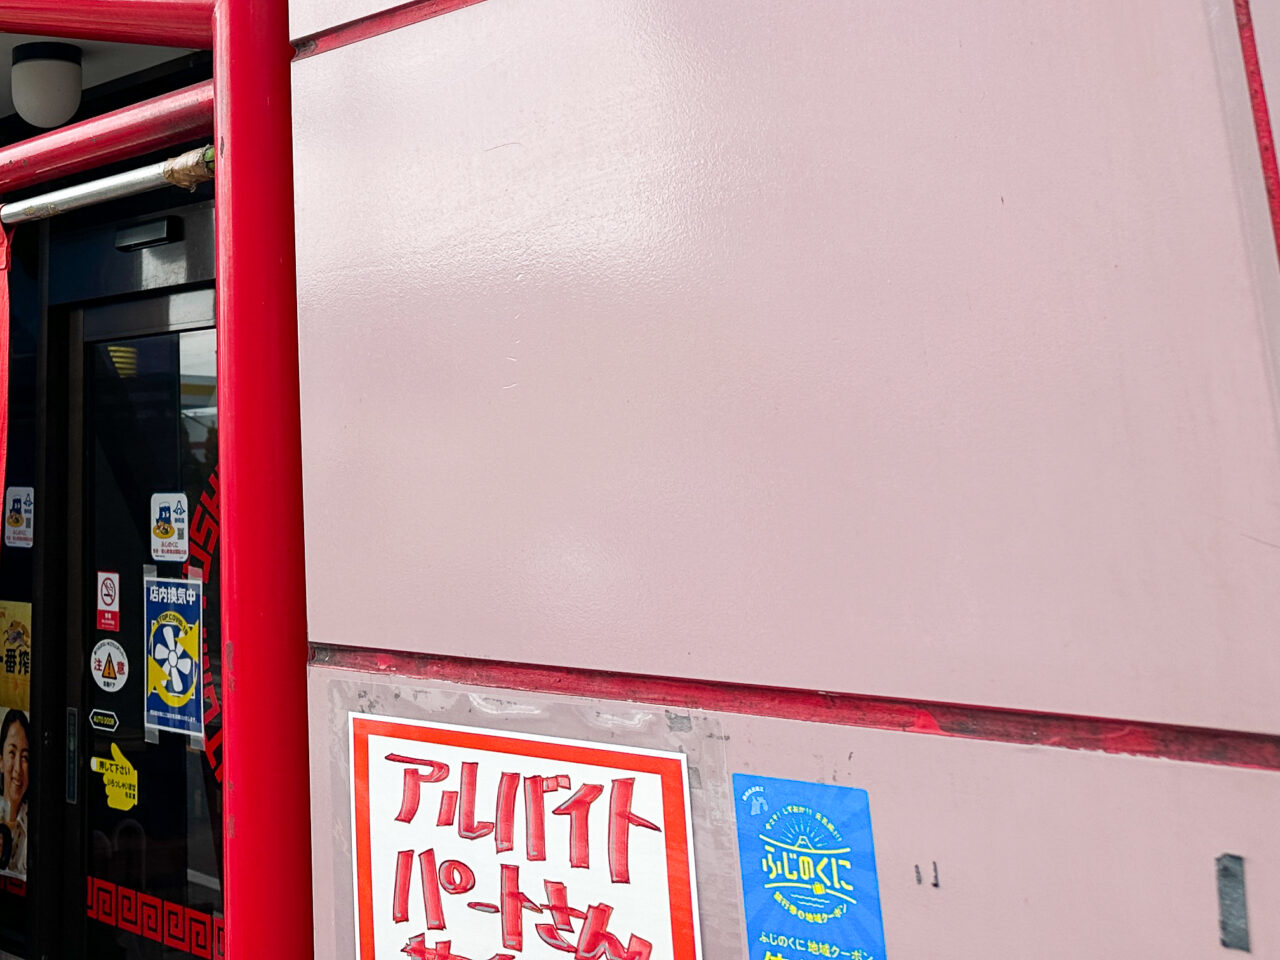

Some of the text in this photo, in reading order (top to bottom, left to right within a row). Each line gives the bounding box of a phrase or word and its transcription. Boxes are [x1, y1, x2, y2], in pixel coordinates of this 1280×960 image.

[149, 585, 196, 606] 店内換気中
[99, 760, 131, 776] 押して下さい
[384, 752, 662, 885] アルバイト
[761, 844, 854, 891] ふじのくに
[393, 848, 653, 960] パートさん
